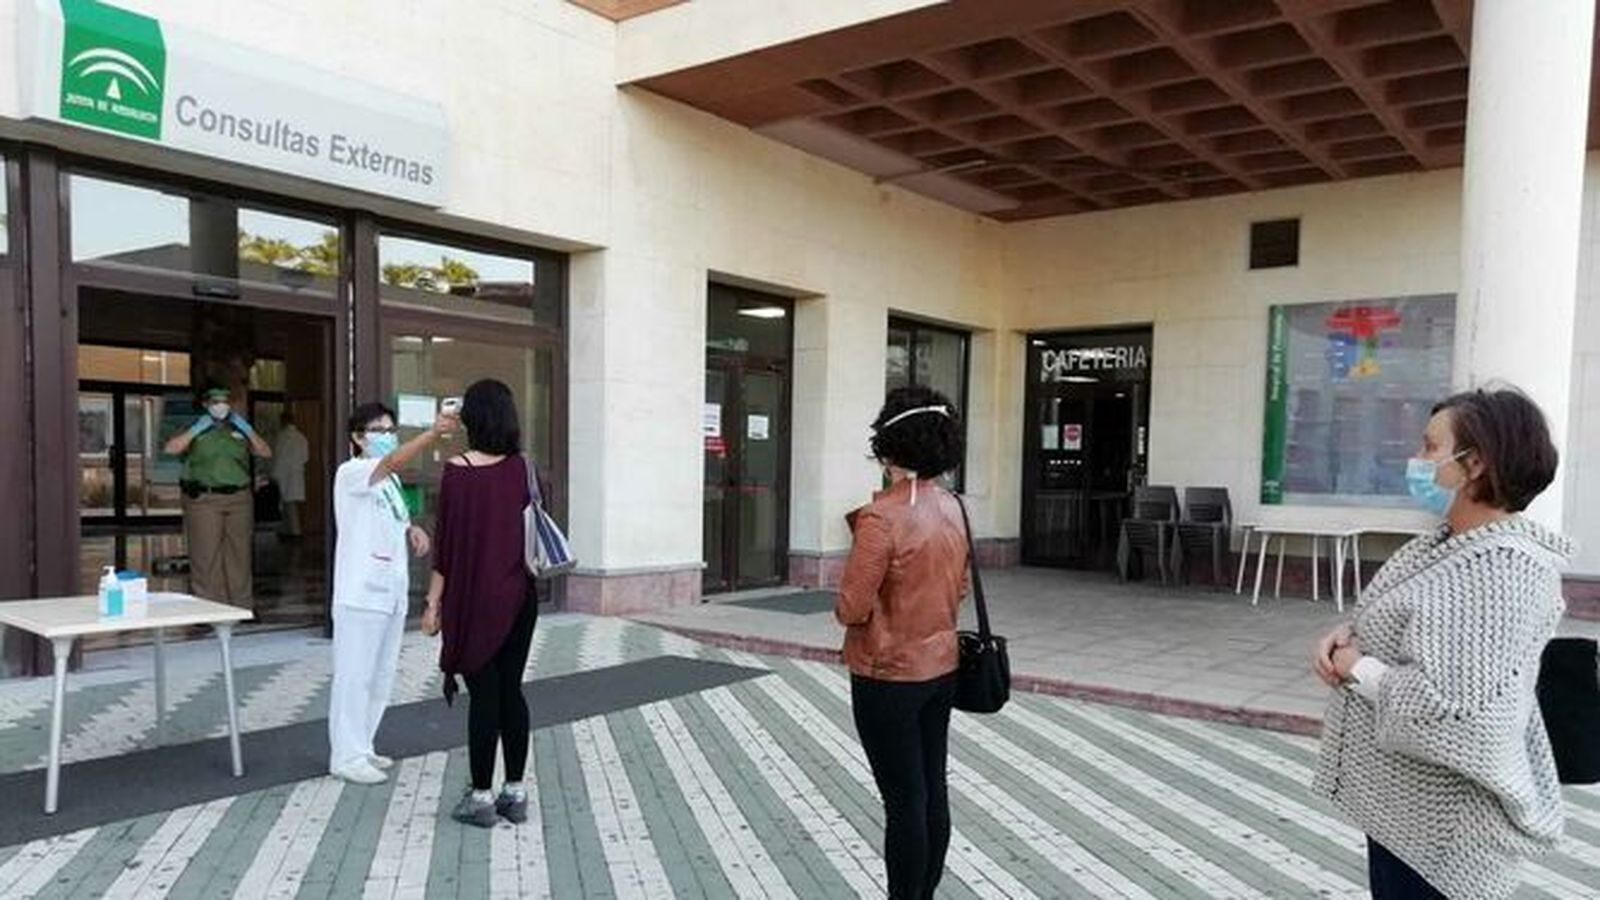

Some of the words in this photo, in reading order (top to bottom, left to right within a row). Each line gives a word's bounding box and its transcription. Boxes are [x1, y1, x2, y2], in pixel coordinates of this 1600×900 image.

[175, 94, 319, 158] Consultas
[330, 134, 434, 186] Externas
[1043, 345, 1147, 372] CAFETERIA
